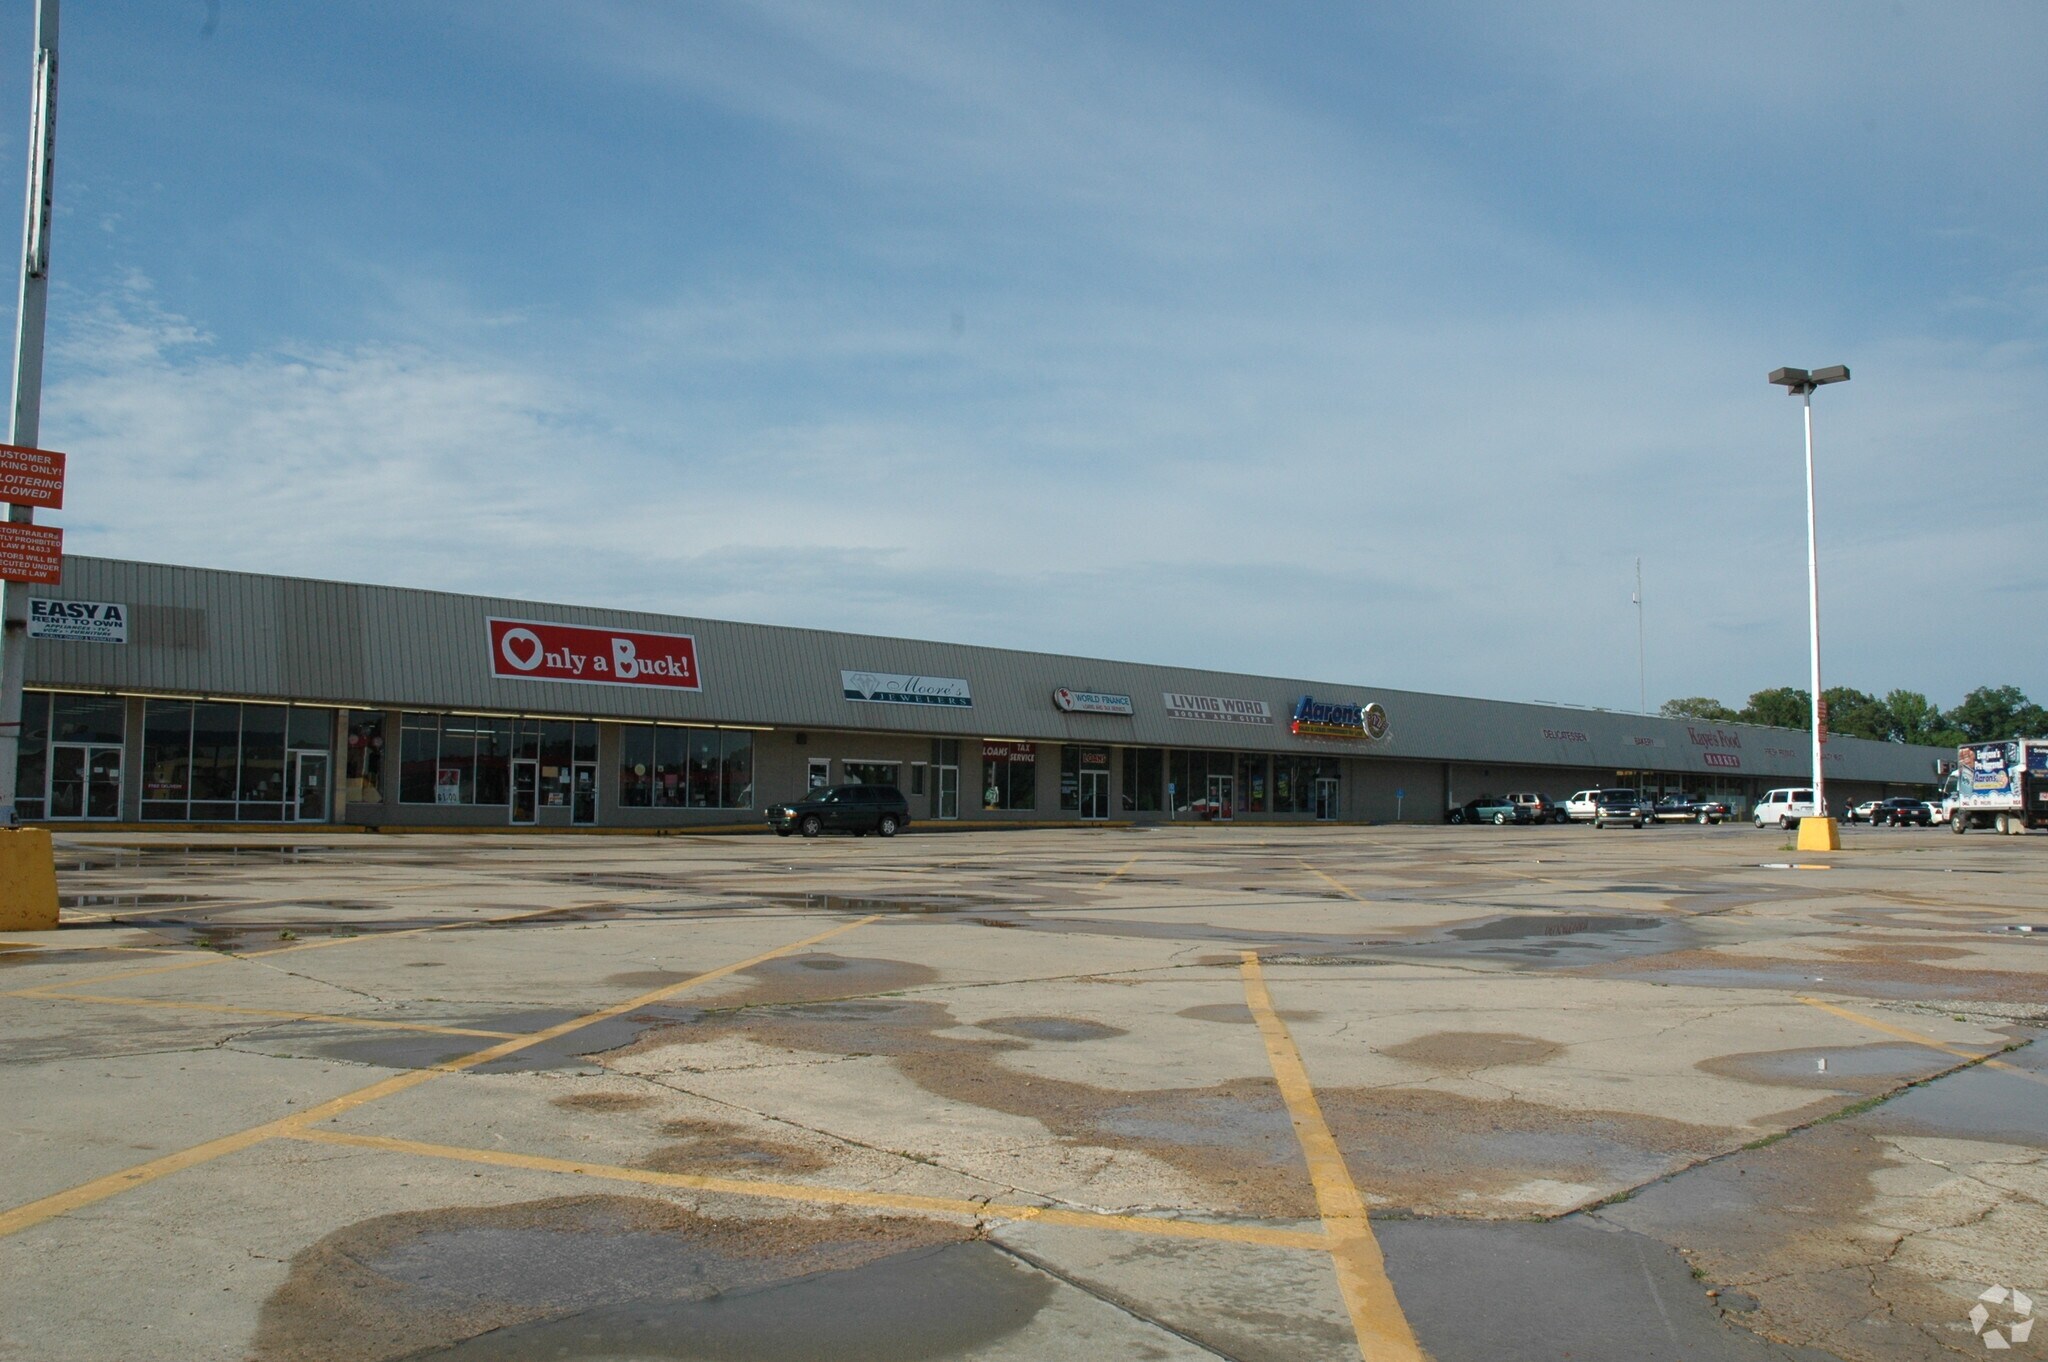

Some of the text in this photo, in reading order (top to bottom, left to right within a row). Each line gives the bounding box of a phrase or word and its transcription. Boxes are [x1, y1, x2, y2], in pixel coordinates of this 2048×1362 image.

[0, 450, 51, 464] USTOMER
[1, 460, 62, 476] KING ONLY!
[0, 485, 51, 499] LOWED!
[1, 542, 19, 550] LAW
[15, 536, 61, 547] PROHIBITED
[26, 554, 45, 563] WILL
[2, 567, 47, 578] STATE LAW
[32, 563, 60, 572] UNDER
[32, 600, 122, 621] EASY A
[32, 616, 68, 624] RENT
[94, 620, 123, 628] OWN
[501, 628, 690, 679] Only a Buck!
[887, 676, 962, 697] Moore's
[880, 693, 967, 705] JEWELERS
[1075, 694, 1129, 705] WORLD FINANCE
[1171, 695, 1264, 715] LIVING WORD
[1297, 696, 1363, 725] Aaron's
[1175, 710, 1206, 719] BOOKS
[1717, 729, 1742, 749] Food
[982, 746, 1008, 756] LOANS
[1017, 744, 1031, 752] TAX
[1010, 753, 1035, 762] SERVICE
[1705, 755, 1739, 766] MARKET
